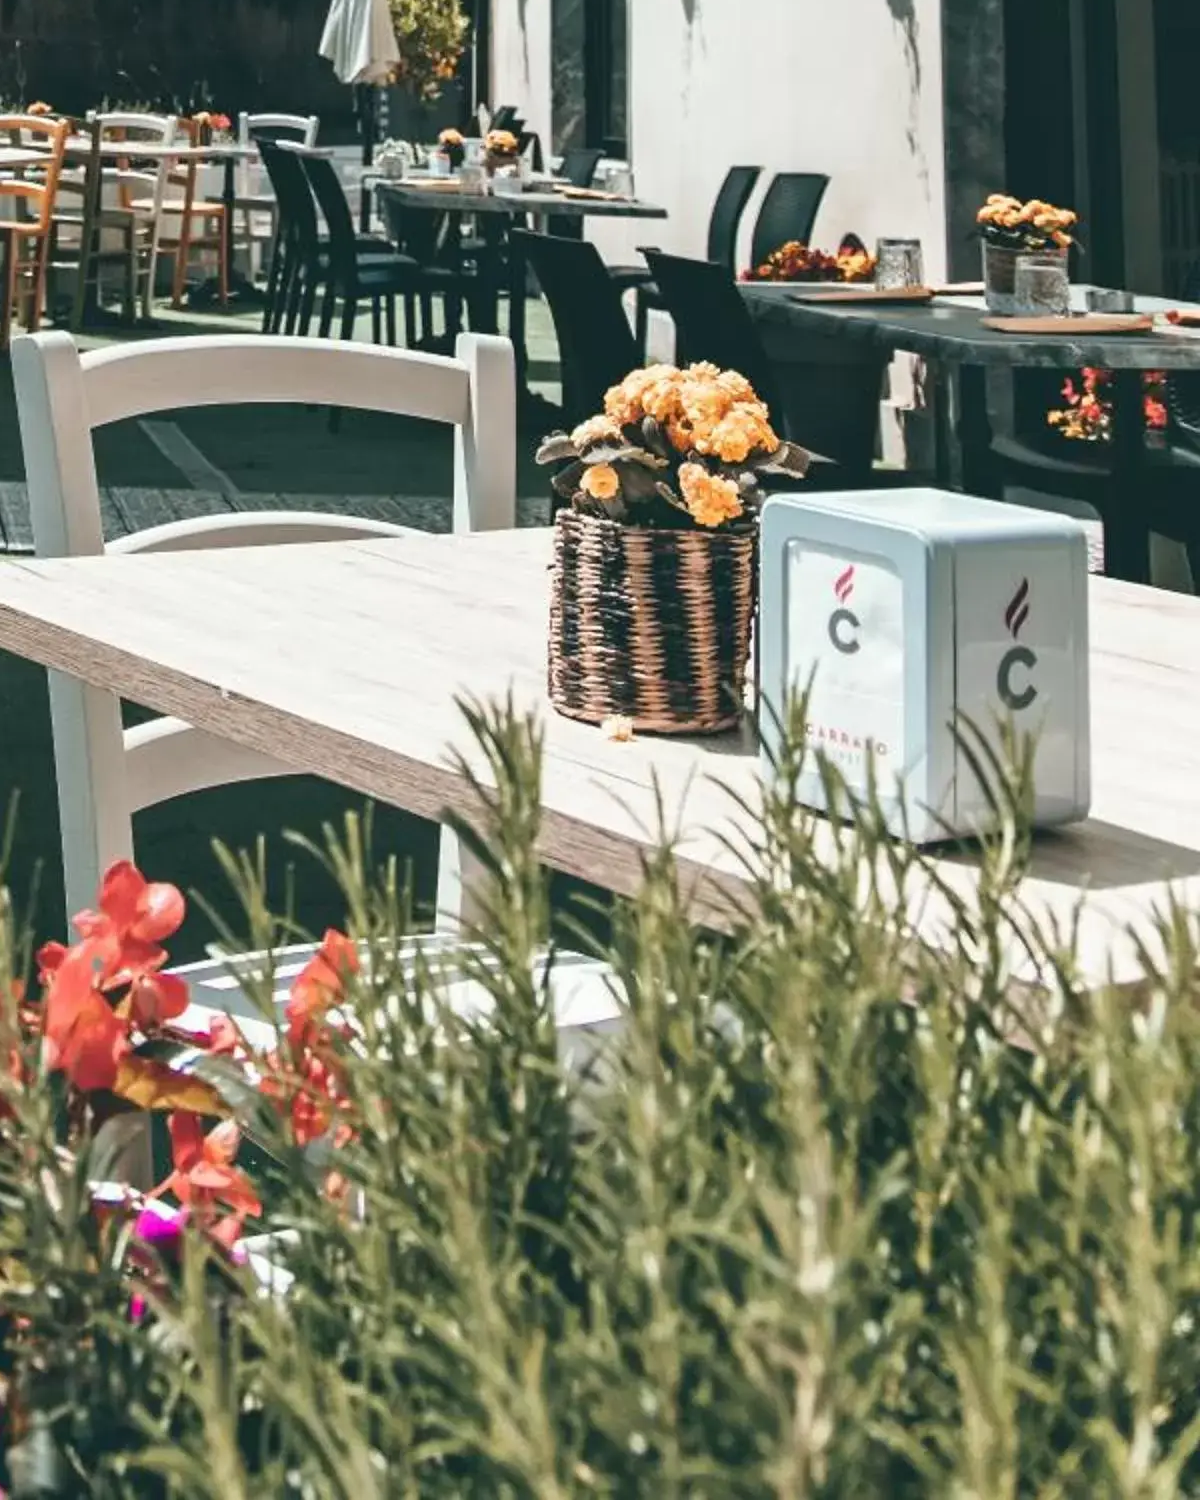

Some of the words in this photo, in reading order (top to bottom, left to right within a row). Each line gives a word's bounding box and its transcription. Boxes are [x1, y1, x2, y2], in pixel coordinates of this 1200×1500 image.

[828, 608, 861, 654] C
[997, 645, 1038, 710] C
[804, 723, 887, 756] CARRAO
